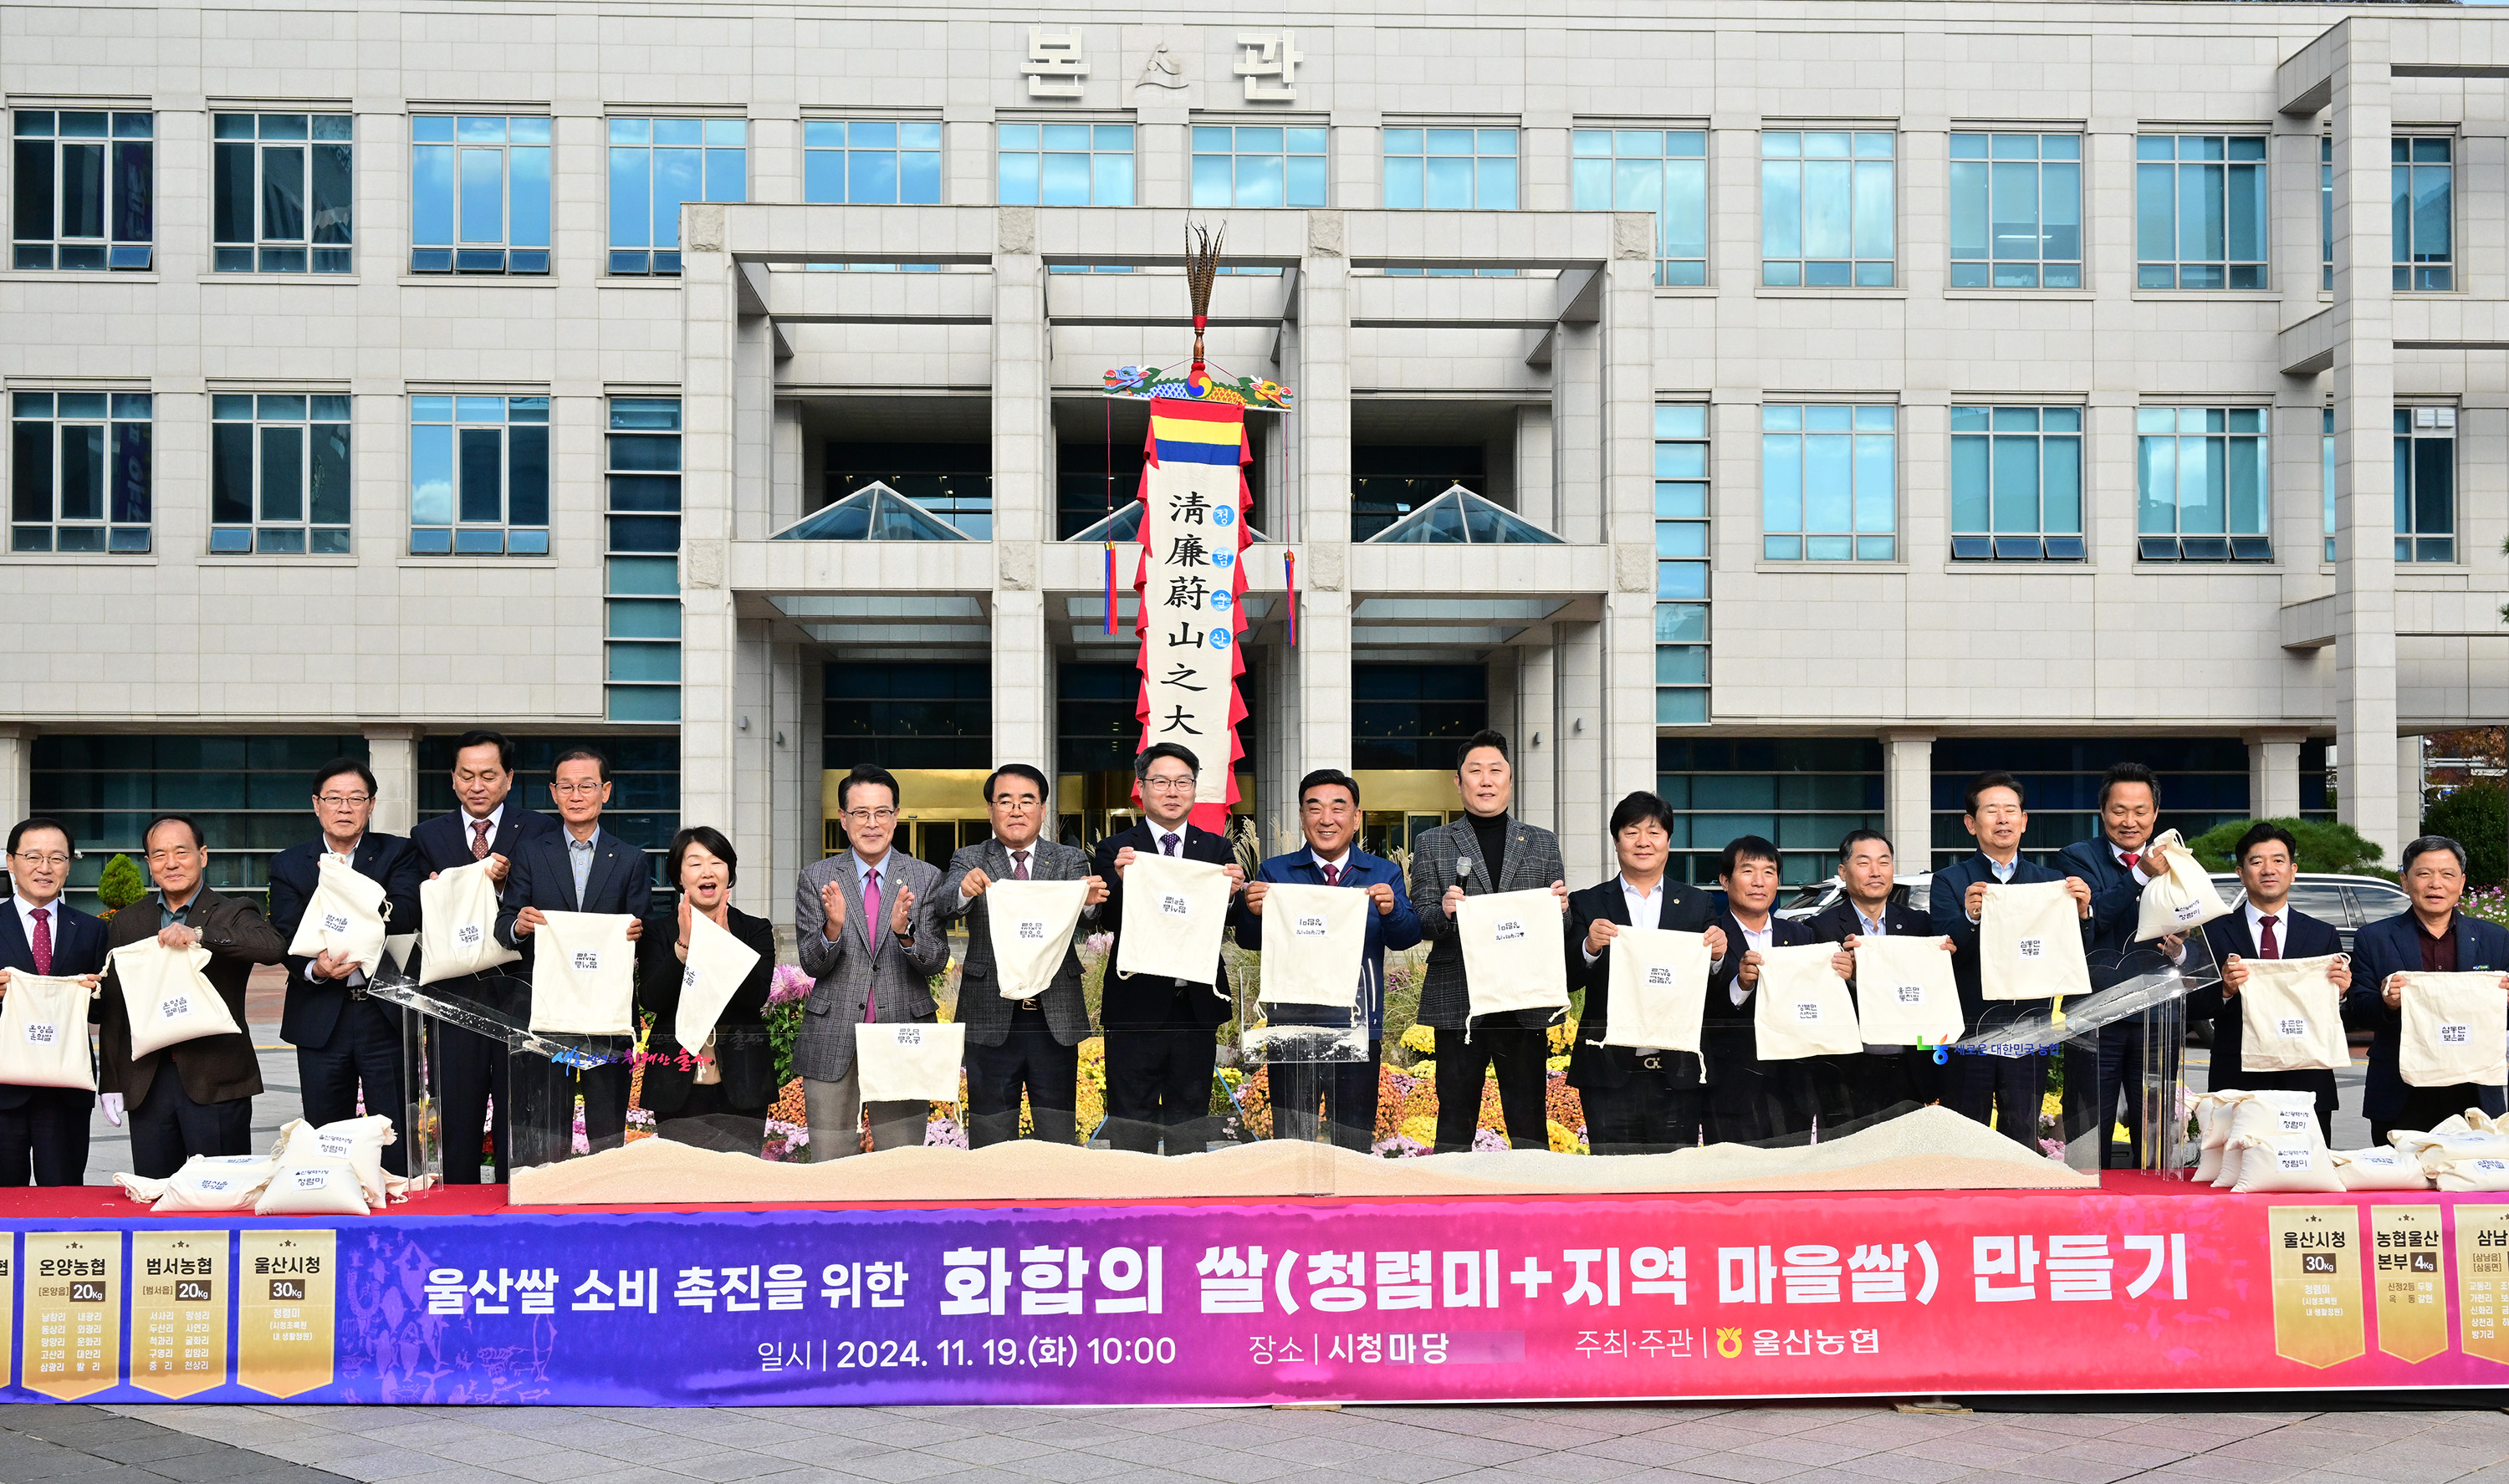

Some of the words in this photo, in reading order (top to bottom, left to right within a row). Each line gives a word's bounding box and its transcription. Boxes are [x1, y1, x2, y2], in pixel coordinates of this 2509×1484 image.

[2179, 909, 2200, 920] 청렴미
[1299, 918, 1322, 926] 청렴미
[1498, 921, 1520, 931] 청렴미
[575, 961, 597, 969] 범서읍
[162, 997, 187, 1011] 온양읍
[29, 1025, 54, 1034] 온양읍
[897, 1036, 921, 1044] 온양읍
[2443, 1033, 2465, 1042] 보은쌀
[1954, 1043, 1987, 1056] 새로운
[1991, 1043, 2035, 1056] 대한민국
[2038, 1043, 2059, 1056] 농협
[673, 1047, 713, 1073] 울산
[321, 1145, 346, 1155] 청렴미
[2282, 1160, 2307, 1168] 청렴미
[298, 1178, 324, 1186] 청렴미
[2283, 1231, 2346, 1248] 울산시청
[2377, 1230, 2439, 1247] 농협울산
[146, 1257, 212, 1275] 범서농협
[254, 1257, 320, 1274] 울산시청
[2306, 1256, 2333, 1272] 30Kg
[2378, 1253, 2408, 1270] 본부
[39, 1258, 105, 1277] 온양농협
[424, 1267, 560, 1315] 울산쌀
[571, 1267, 658, 1313] 소비
[673, 1264, 807, 1313] 촉진을
[820, 1260, 909, 1308] 위한
[939, 1245, 1163, 1316] 화합의
[1718, 1240, 1939, 1305] 마을쌀)
[1973, 1233, 2188, 1303] 만들기
[179, 1283, 208, 1299] 20Kg
[273, 1282, 302, 1298] 30Kg
[2304, 1284, 2330, 1294] 청렴미
[2418, 1282, 2433, 1292] 두왕
[2469, 1281, 2492, 1291] 교동리
[74, 1284, 103, 1300] 20Kg
[2418, 1294, 2434, 1304] 갈현
[2470, 1293, 2492, 1303] 가천리
[273, 1308, 300, 1318] 청렴미
[2306, 1308, 2313, 1316] 내
[2471, 1305, 2493, 1315] 신화리
[150, 1311, 174, 1320] 서사리
[186, 1311, 210, 1320] 망성리
[186, 1323, 209, 1333] 사연리
[2471, 1318, 2494, 1328] 상천리
[150, 1323, 173, 1334] 두산리
[273, 1332, 281, 1341] 내
[2471, 1329, 2495, 1339] 방기리
[41, 1338, 65, 1347] 망양리
[150, 1336, 173, 1345] 척과리
[1752, 1327, 1879, 1356] 울산농협
[41, 1349, 64, 1359] 고산리
[77, 1349, 100, 1359] 대안리
[149, 1349, 173, 1358] 구영리
[185, 1349, 209, 1358] 입암리
[758, 1340, 810, 1372] 일시
[837, 1340, 928, 1369] 2024.
[937, 1339, 973, 1366] 11.
[1087, 1337, 1176, 1365] 10:00
[1249, 1335, 1305, 1365] 장소
[185, 1361, 208, 1370] 천상리
